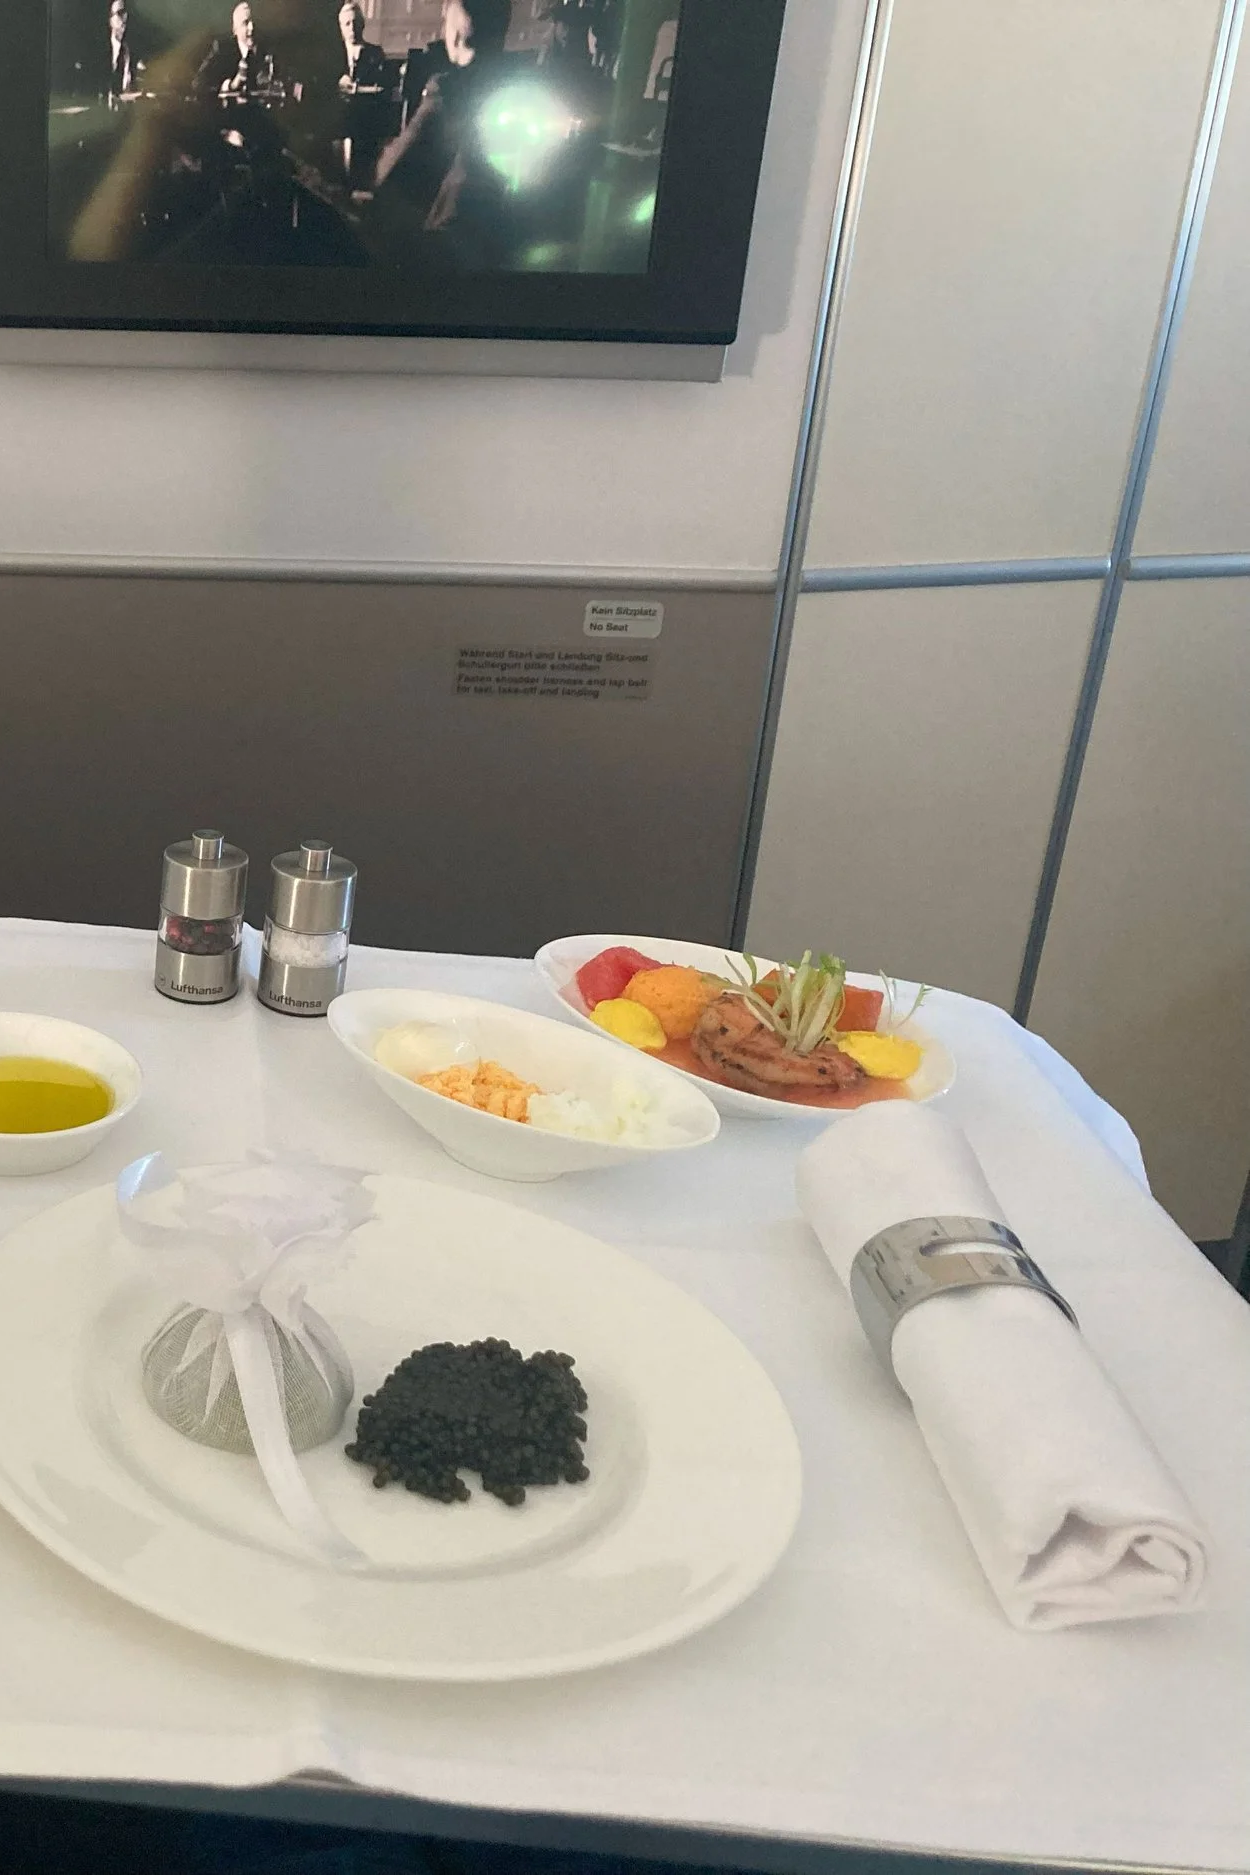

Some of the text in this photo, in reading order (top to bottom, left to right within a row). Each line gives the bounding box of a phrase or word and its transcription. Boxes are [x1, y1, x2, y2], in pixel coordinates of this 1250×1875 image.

[591, 606, 658, 618] Kein Sitzplatz
[589, 622, 628, 632] No Seat
[170, 980, 224, 996] Lufthansa
[268, 990, 322, 1009] Lufthansa
